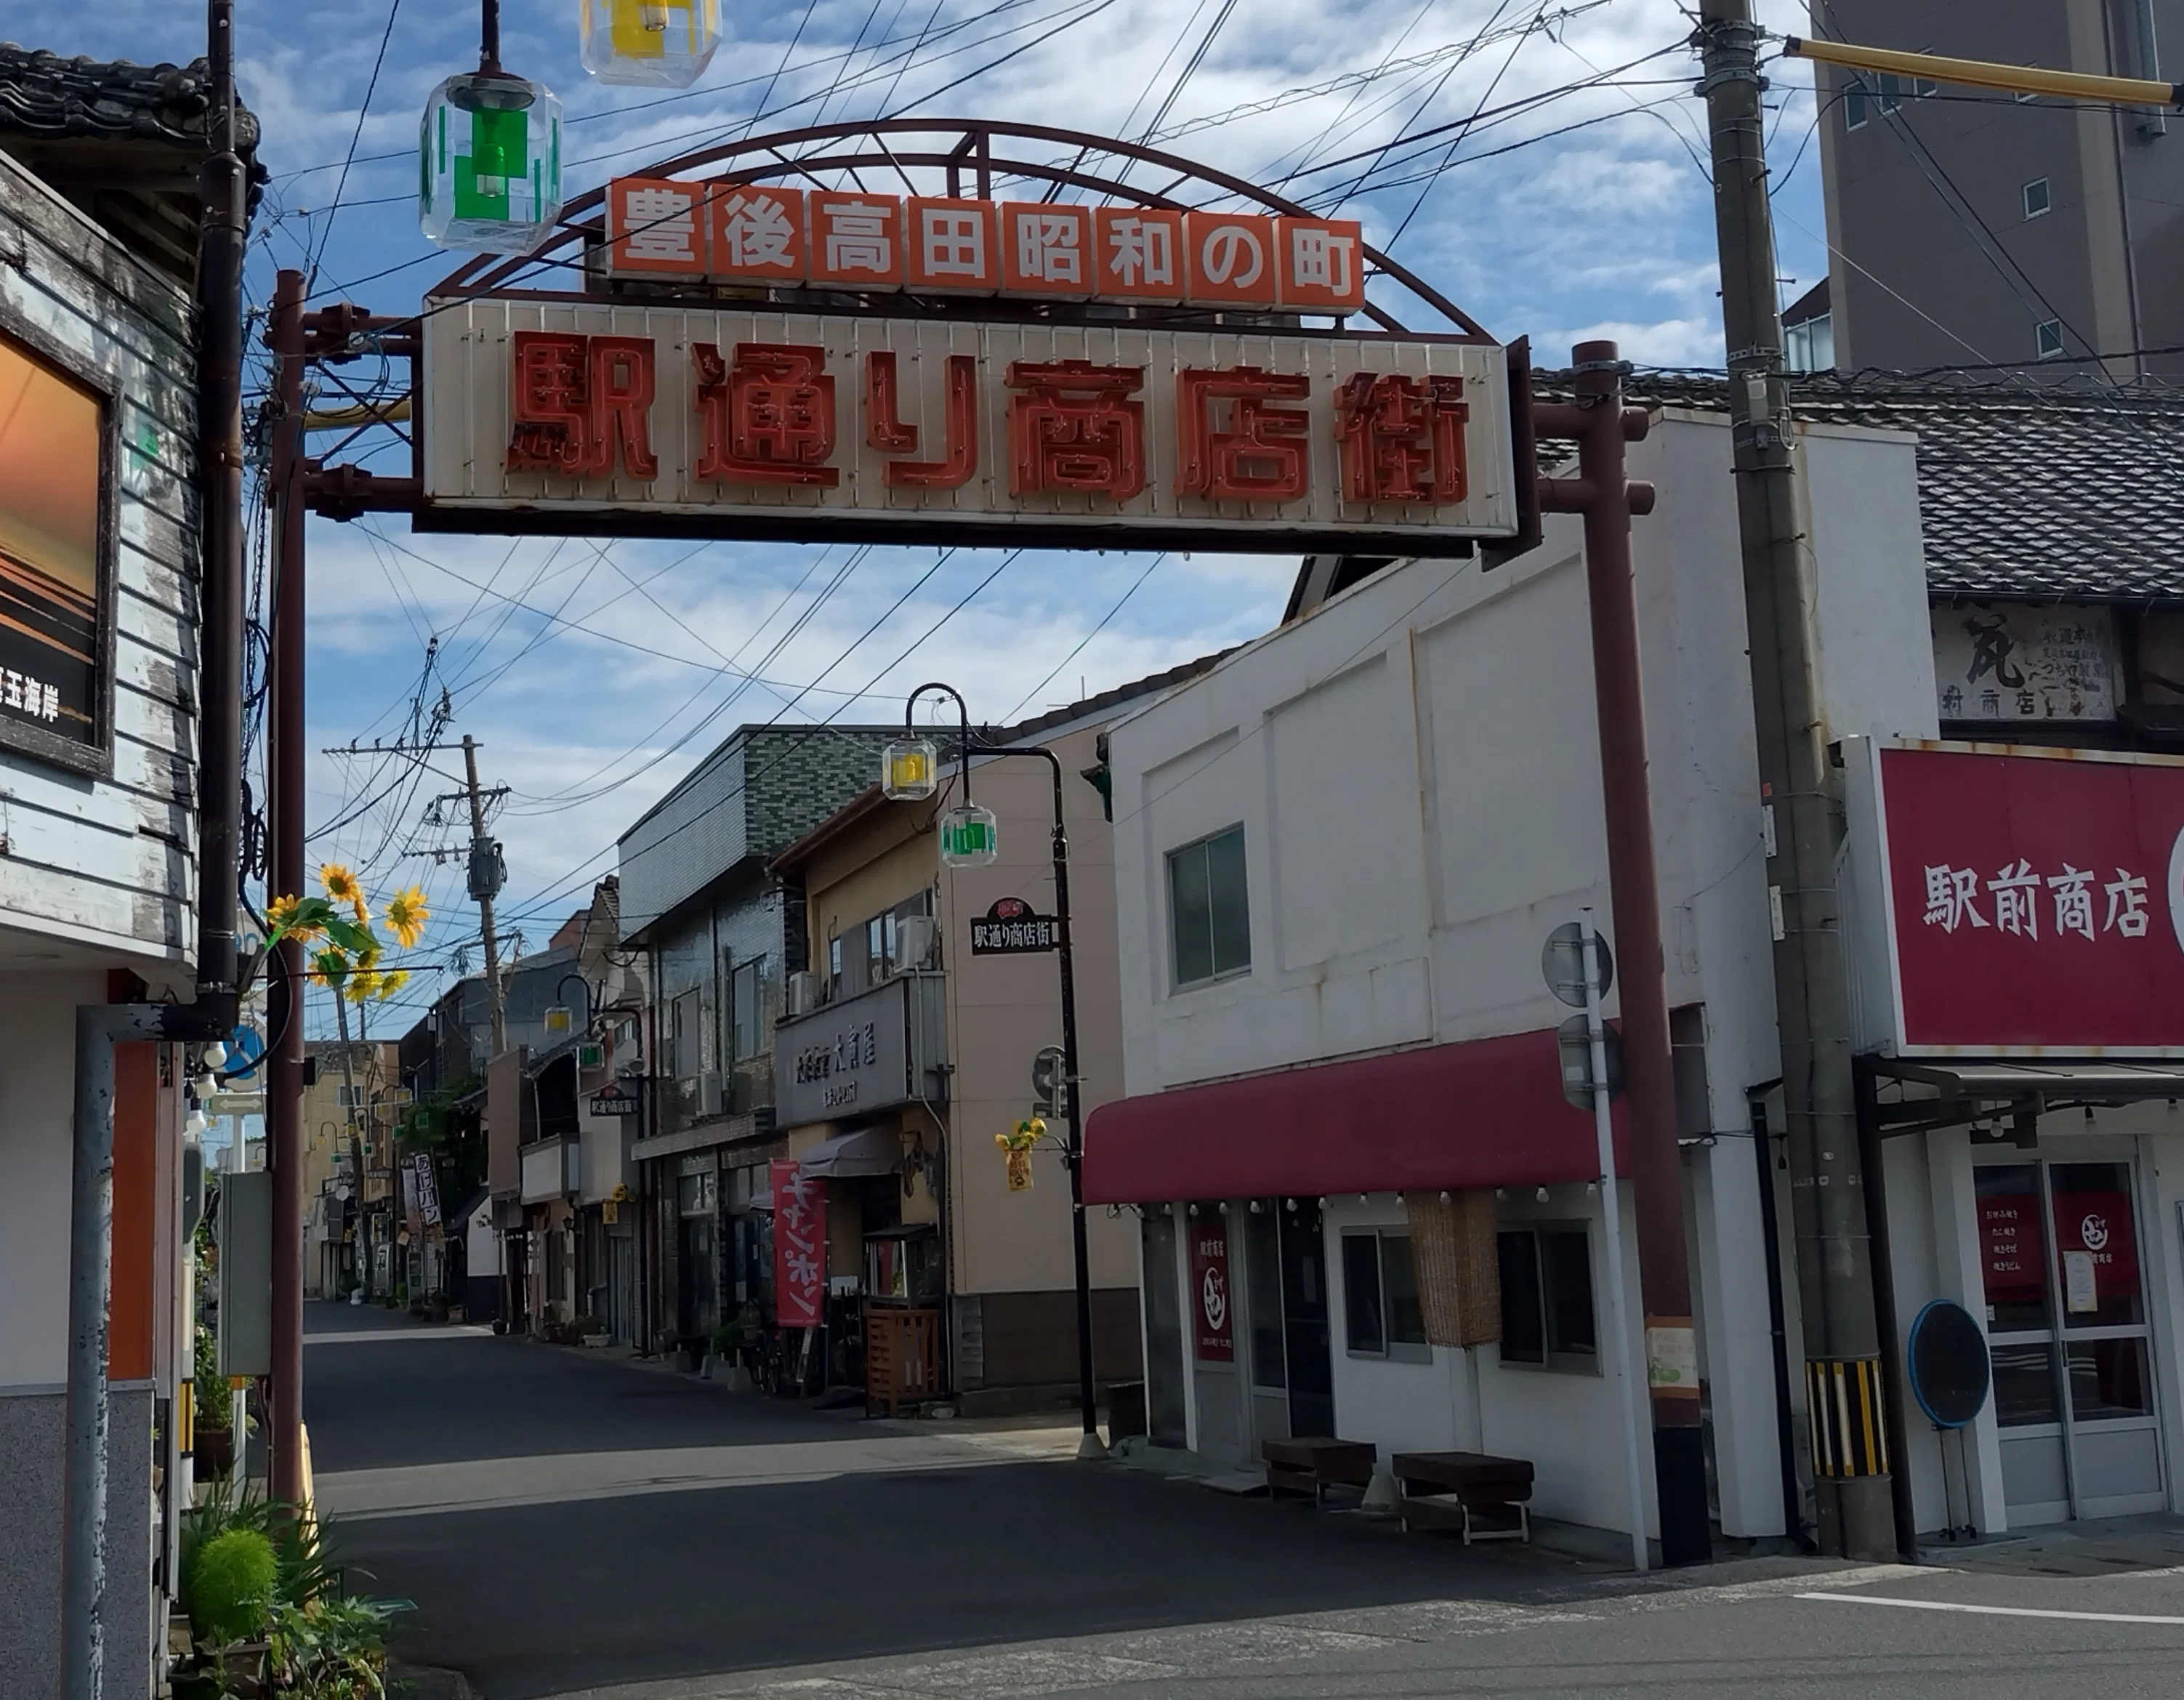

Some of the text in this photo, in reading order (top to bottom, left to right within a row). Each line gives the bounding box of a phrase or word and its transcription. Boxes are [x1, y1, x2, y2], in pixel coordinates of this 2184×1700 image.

[624, 189, 1358, 297] 豊後高田昭和の町
[504, 330, 1469, 506] 駅通り商店街
[0, 666, 60, 723] 玉海岸
[974, 921, 1049, 948] 駅通り商店街
[1922, 858, 2151, 943] 駅前商店
